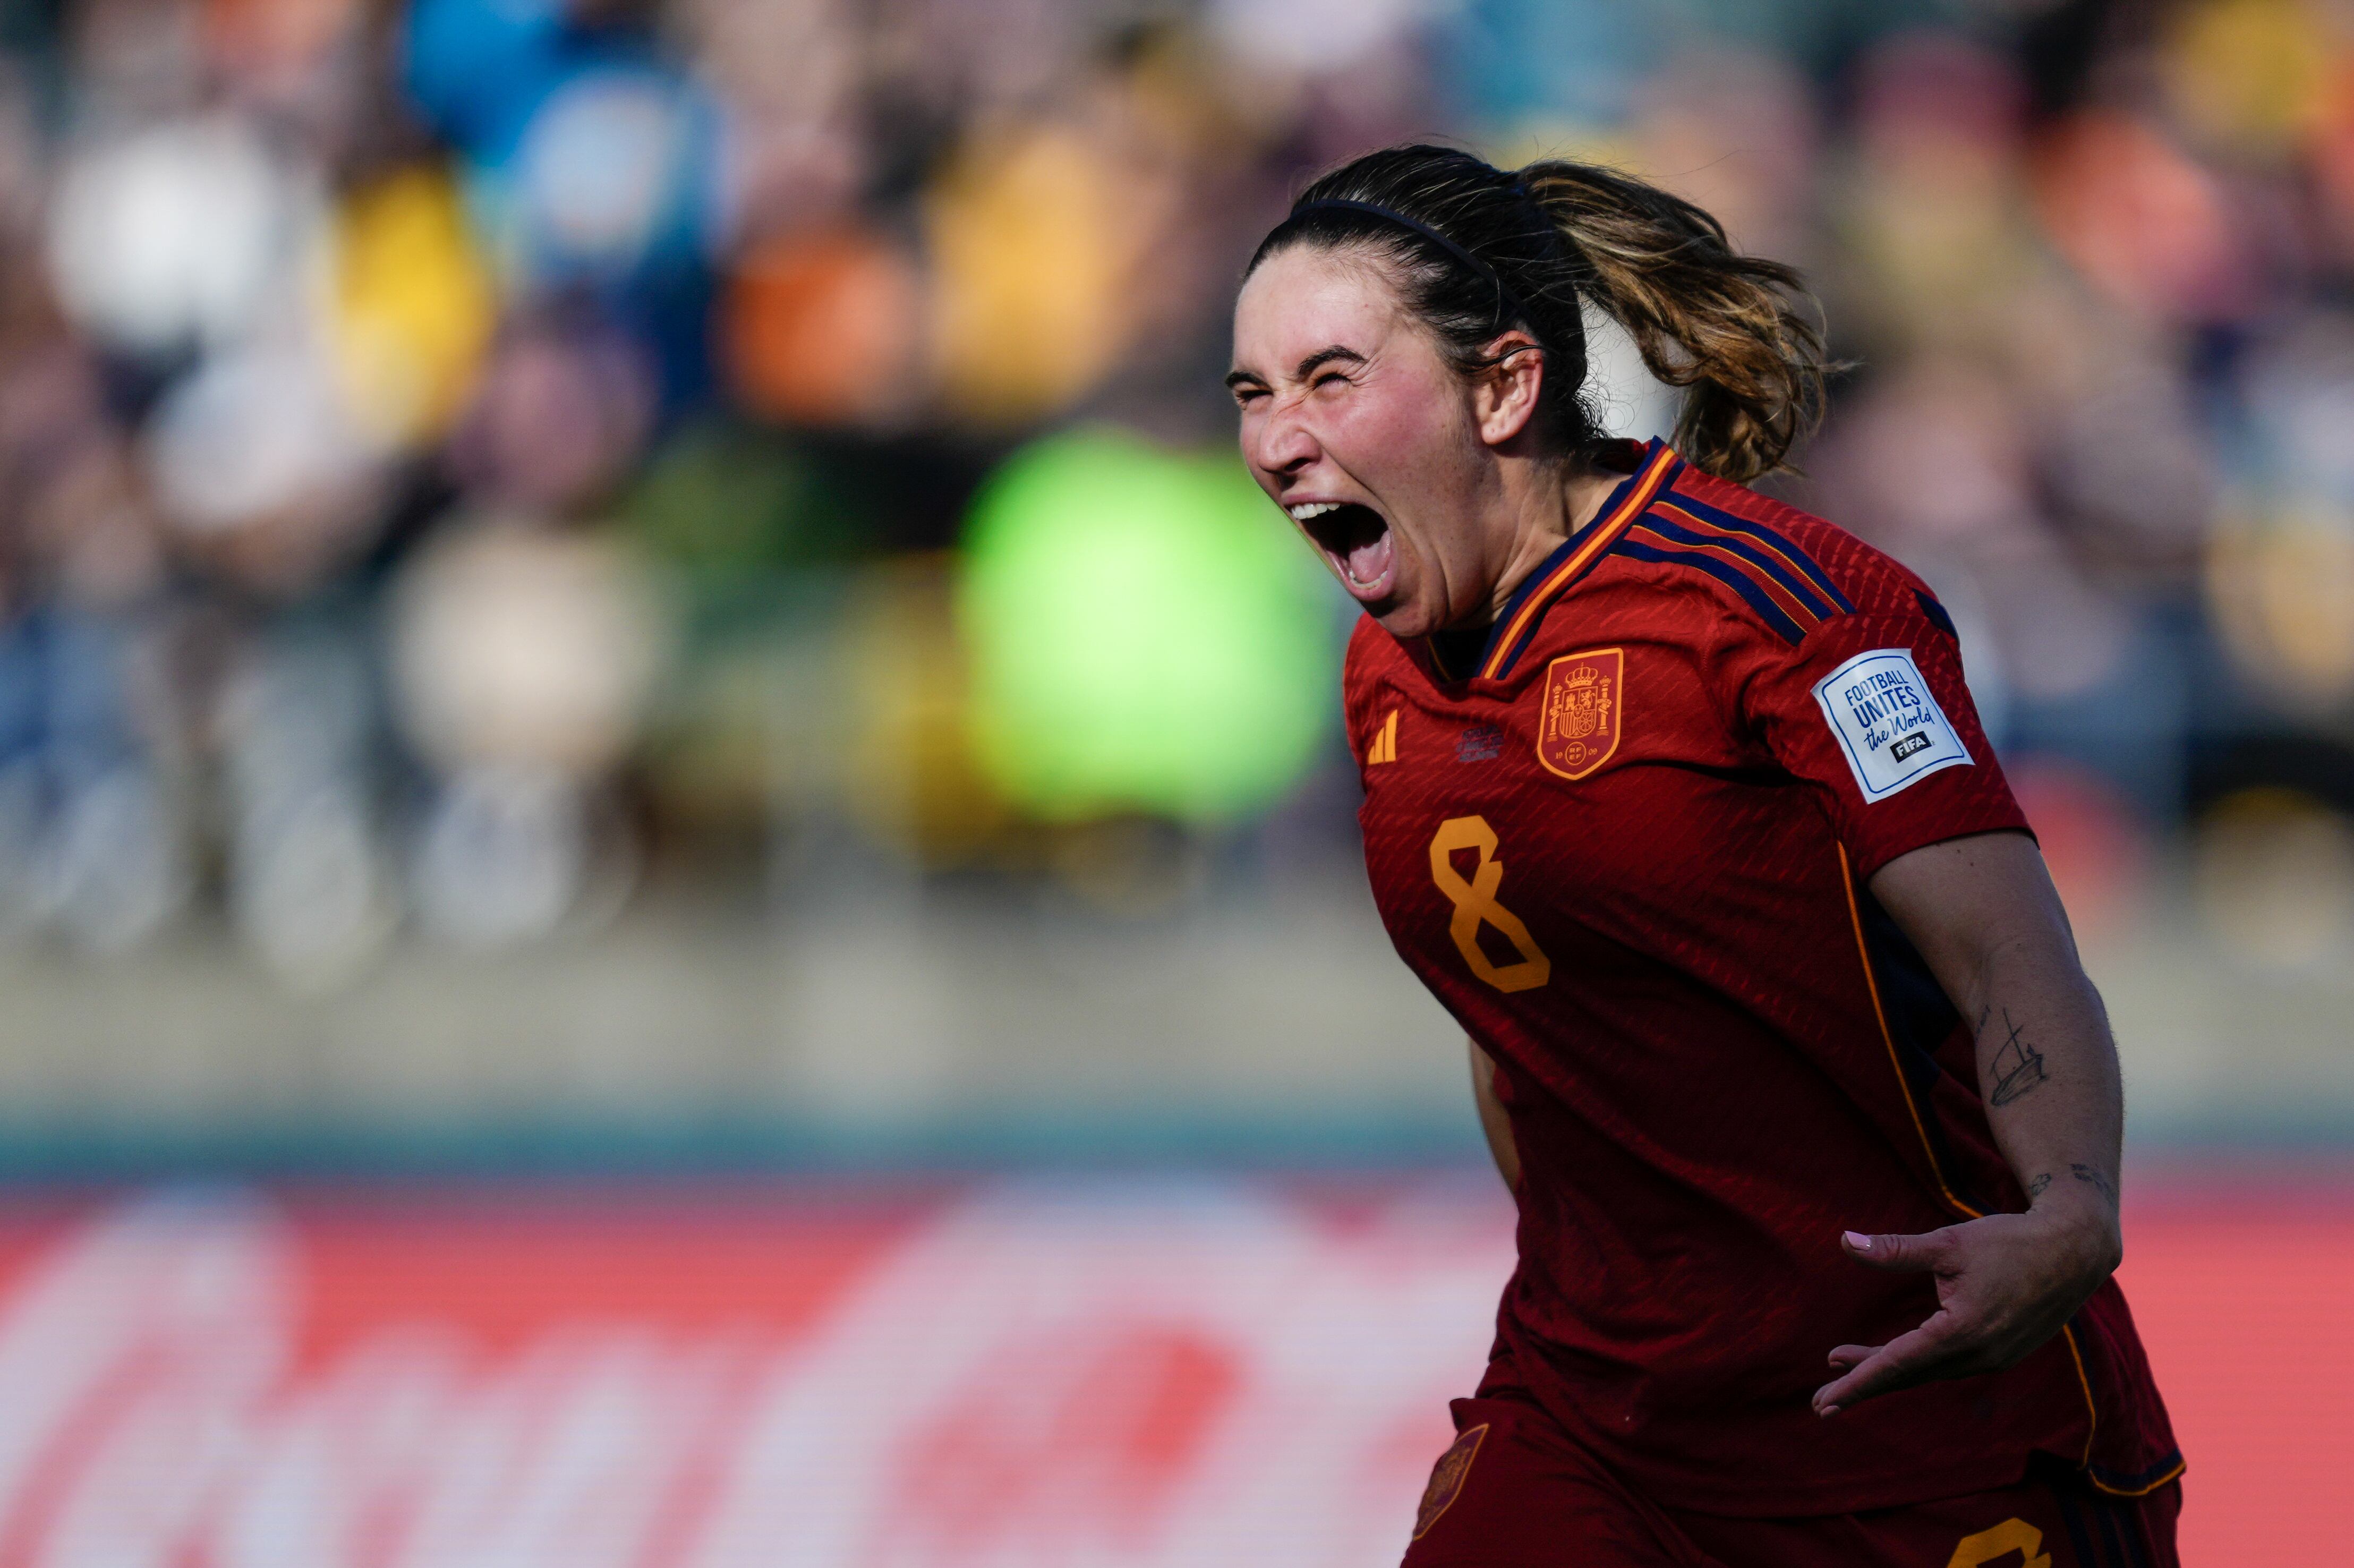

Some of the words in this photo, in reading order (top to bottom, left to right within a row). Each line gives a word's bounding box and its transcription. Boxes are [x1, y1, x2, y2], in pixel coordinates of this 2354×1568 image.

[1845, 670, 1909, 706] FOOTBALL
[1853, 686, 1921, 728] UNITES
[1864, 728, 1889, 751] the
[1887, 706, 1935, 736] World
[1896, 737, 1926, 757] FIFA
[1429, 815, 1551, 993] 8
